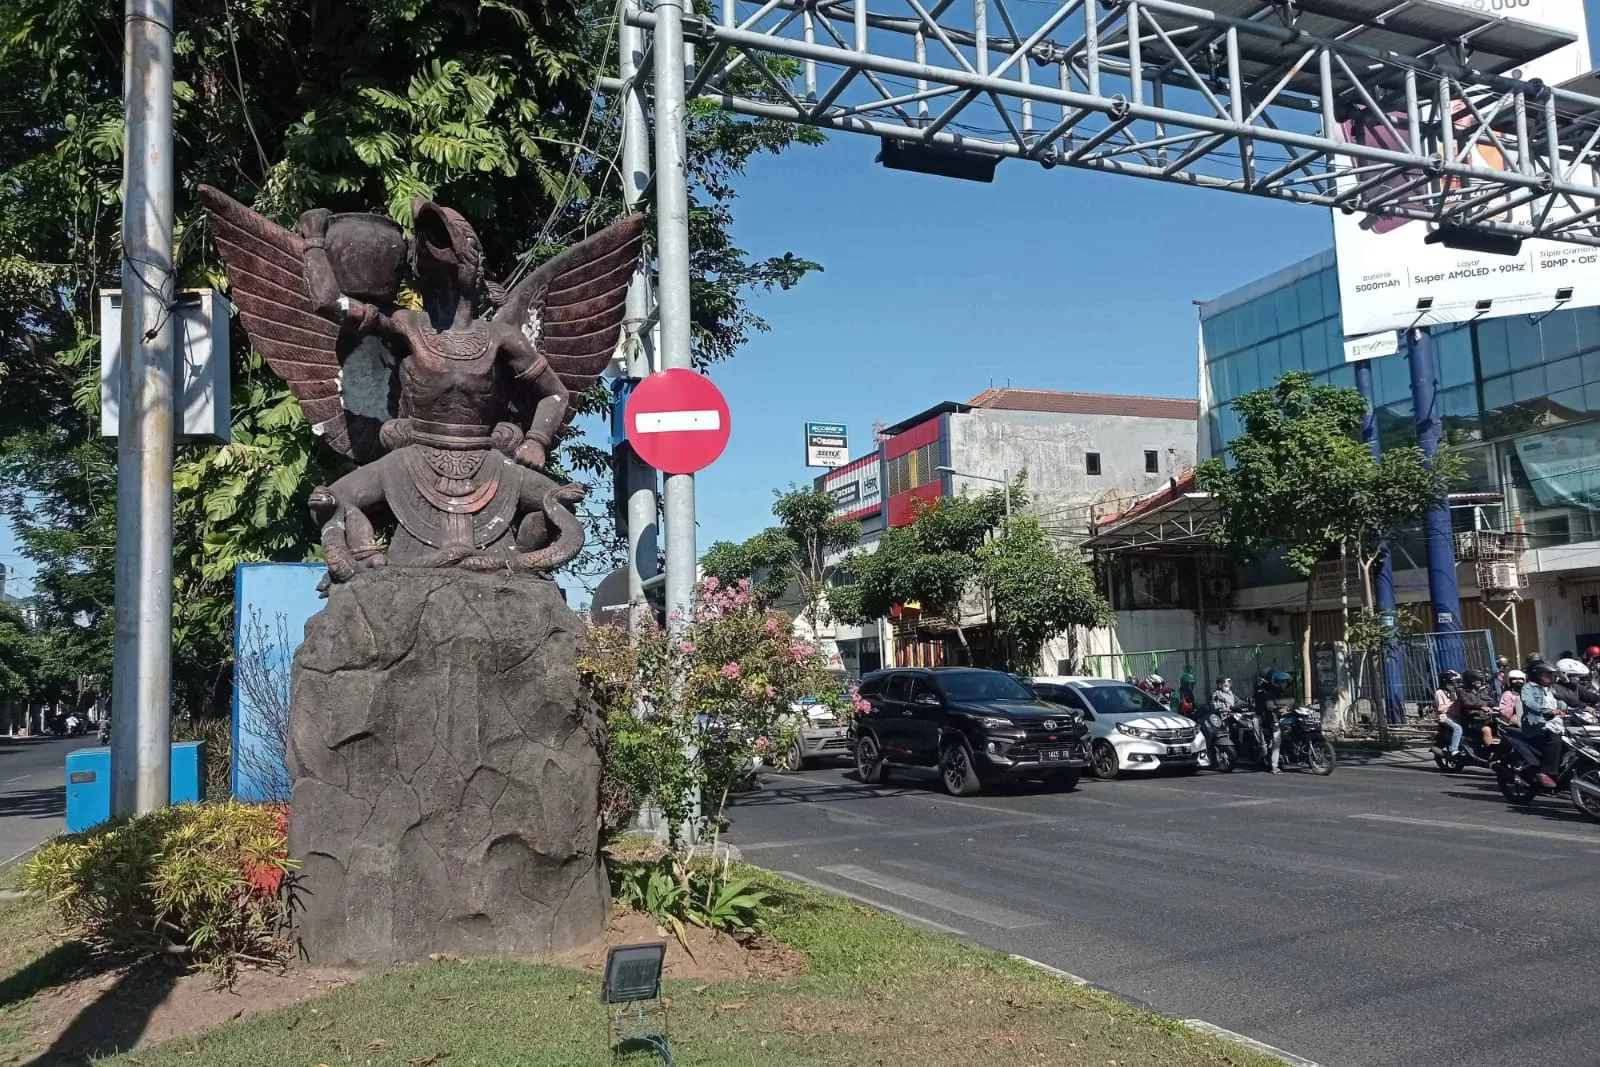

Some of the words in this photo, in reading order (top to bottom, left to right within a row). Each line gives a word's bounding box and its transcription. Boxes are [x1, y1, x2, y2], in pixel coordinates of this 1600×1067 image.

[1540, 250, 1561, 258] Triple
[1541, 258, 1568, 268] 50MP
[1414, 273, 1445, 284] Super
[1448, 267, 1489, 279] AMOLED
[1355, 280, 1401, 292] 5000mAh
